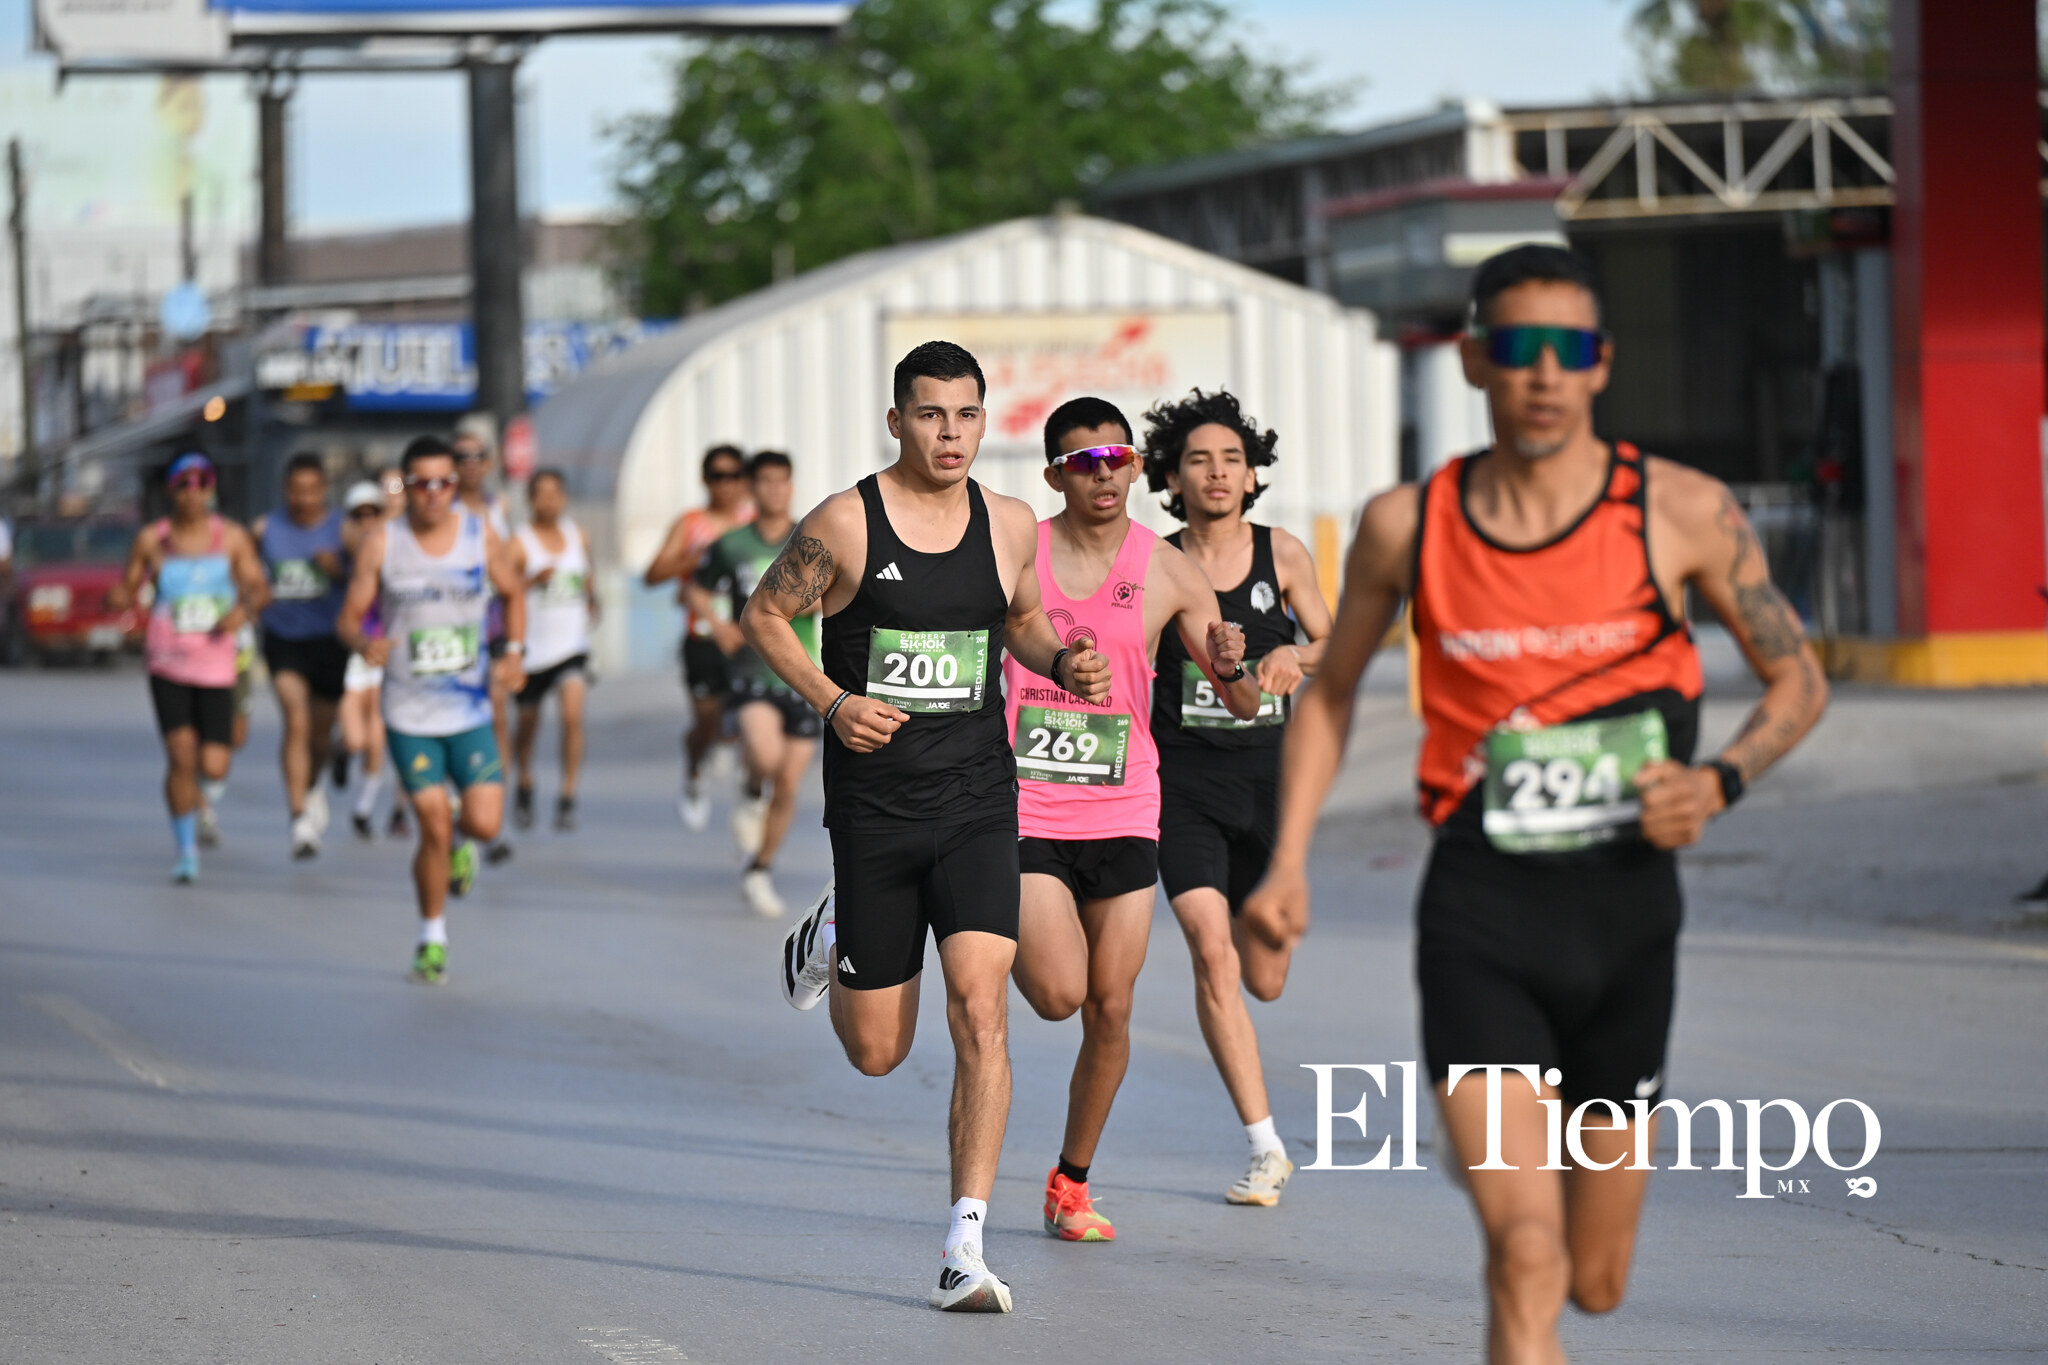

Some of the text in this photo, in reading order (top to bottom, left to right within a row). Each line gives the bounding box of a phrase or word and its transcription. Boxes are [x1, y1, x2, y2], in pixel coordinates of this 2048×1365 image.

[882, 652, 958, 687] 200
[974, 648, 985, 701] MEDALLA
[1020, 687, 1066, 703] CHRISTIAN
[1044, 710, 1088, 720] CARRERA
[1027, 728, 1099, 762] 269
[1113, 730, 1126, 779] MEDALLA
[1502, 754, 1621, 809] 294
